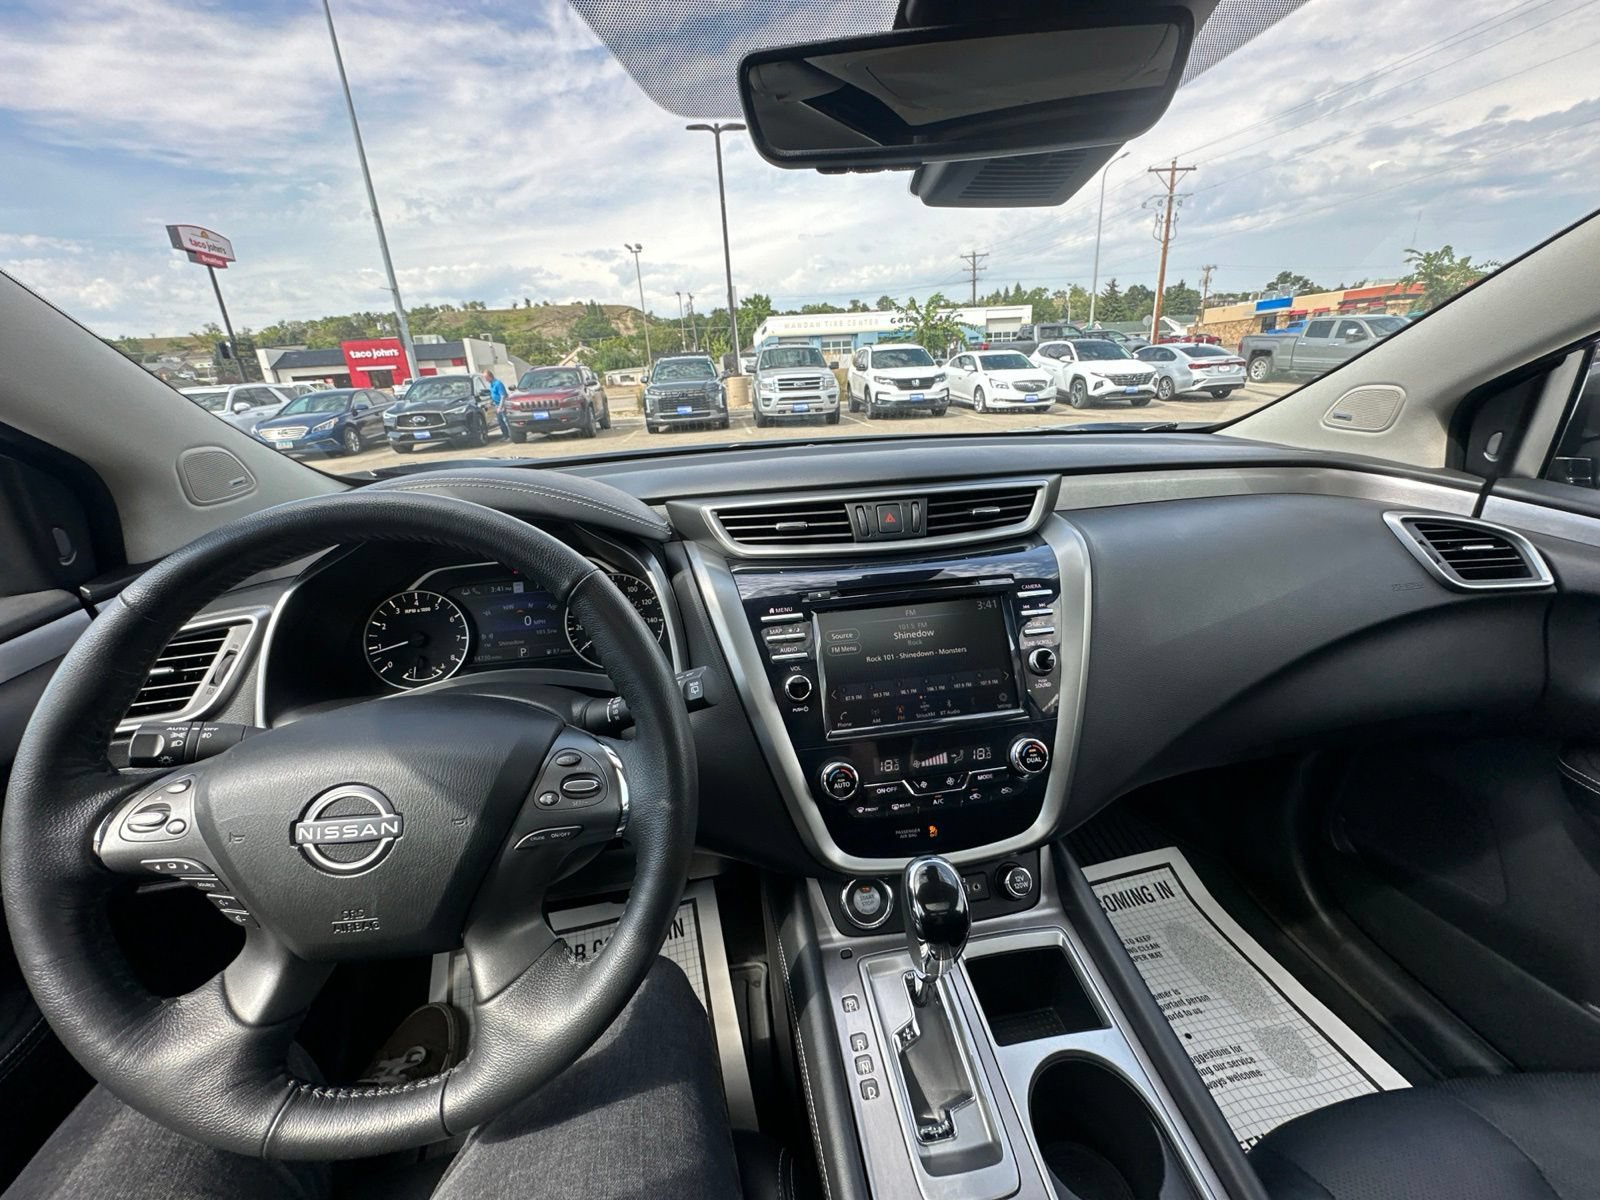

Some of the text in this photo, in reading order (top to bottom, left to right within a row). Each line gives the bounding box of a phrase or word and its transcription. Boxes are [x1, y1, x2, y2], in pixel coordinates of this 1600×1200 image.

[188, 237, 207, 249] taco
[784, 318, 879, 329] MANDAN TIRE CENTER
[349, 348, 400, 360] taco john's
[977, 599, 997, 610] 3:41
[905, 609, 917, 617] FM
[524, 615, 532, 626] 0
[831, 632, 854, 640] Source
[893, 629, 935, 640] Shinedow
[520, 647, 527, 657] P
[866, 655, 882, 663] Rock
[899, 649, 935, 660] Shinedown
[938, 646, 967, 655] Monsters
[298, 820, 399, 841] NISSAN
[1014, 881, 1029, 890] 120W
[1153, 880, 1176, 900] IN
[341, 909, 365, 920] SRS
[333, 921, 381, 934] AIRBAG
[1125, 934, 1152, 946] TO KEEP
[1138, 943, 1161, 952] CLEAN
[1148, 951, 1164, 960] MAT
[1172, 988, 1181, 996] is
[1185, 994, 1211, 1008] person
[1166, 1006, 1205, 1022] orld to us.
[1230, 1044, 1244, 1053] for
[1214, 1061, 1228, 1071] our
[1227, 1056, 1257, 1068] service
[1228, 1068, 1266, 1083] welcome.
